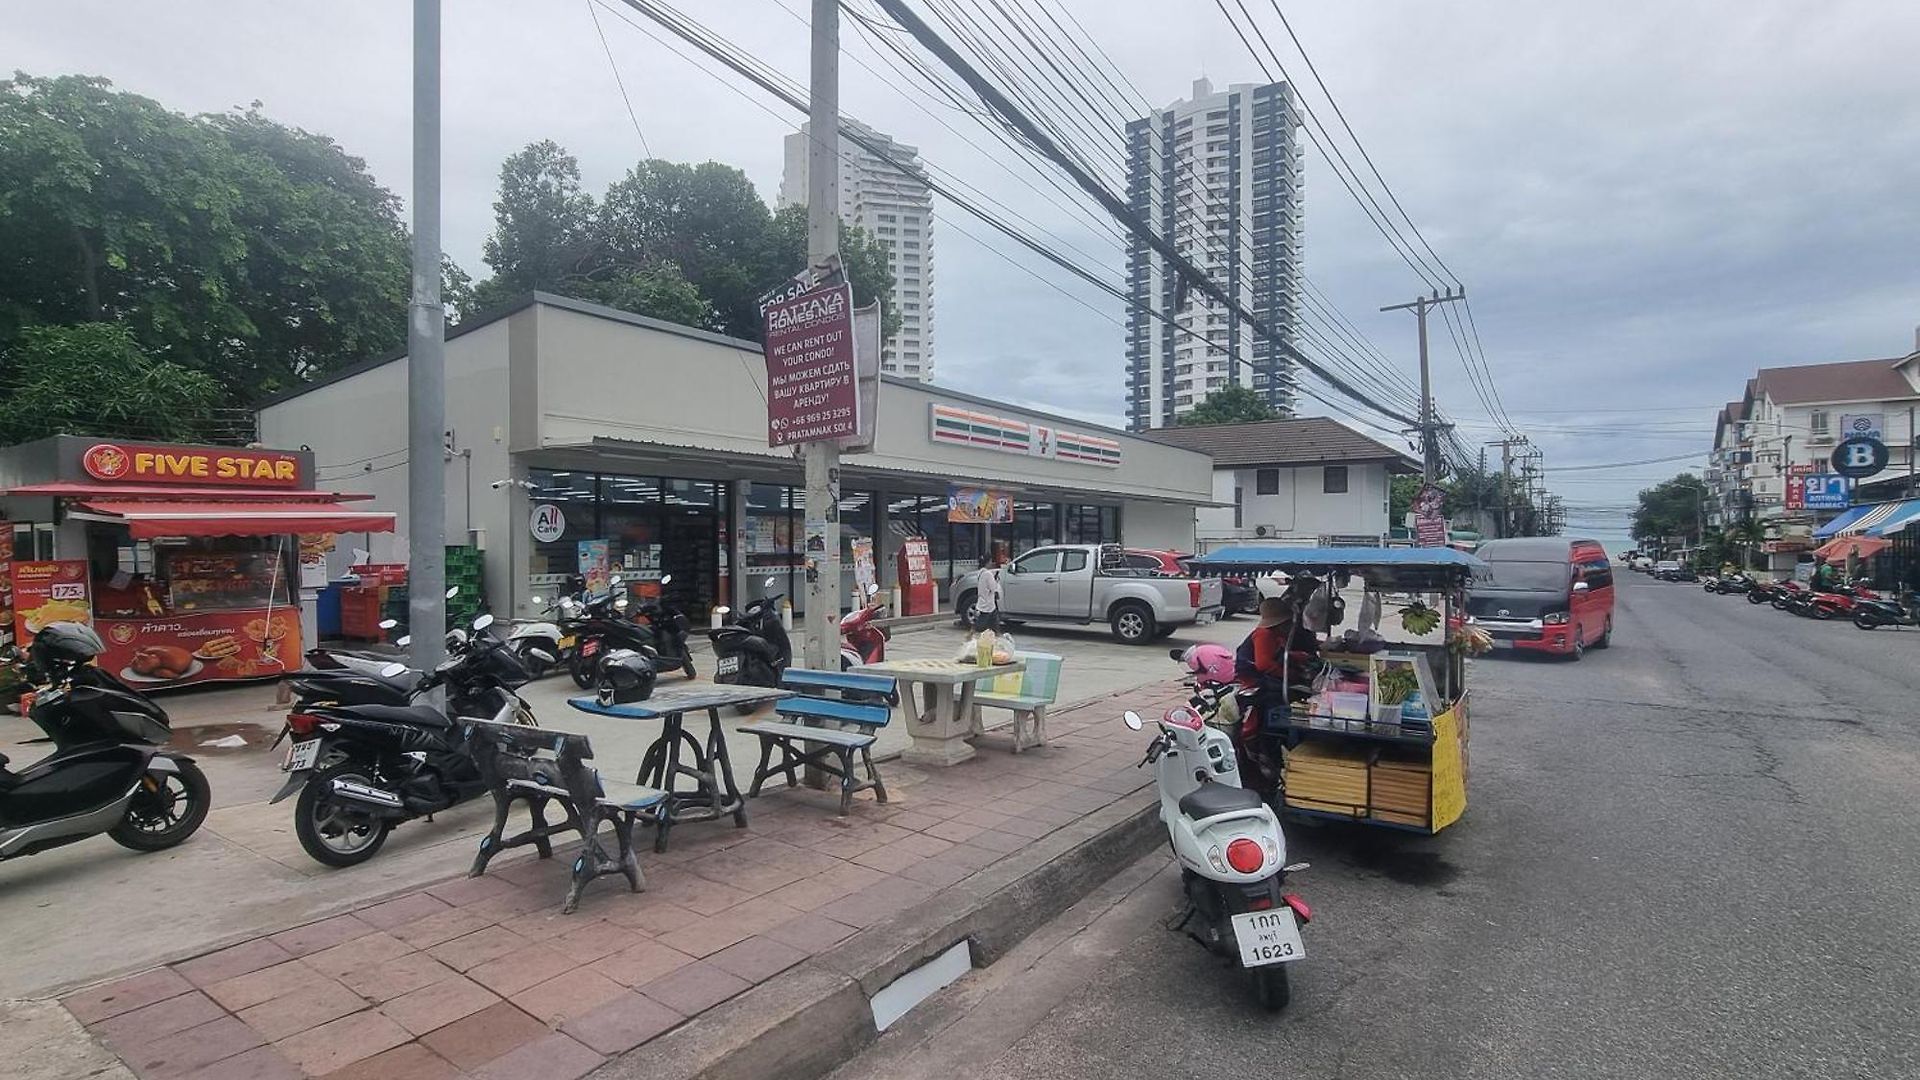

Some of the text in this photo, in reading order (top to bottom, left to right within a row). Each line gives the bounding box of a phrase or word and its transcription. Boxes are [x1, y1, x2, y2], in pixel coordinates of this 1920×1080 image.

[787, 273, 820, 300] SALE
[769, 292, 844, 320] PATTAYA
[769, 303, 843, 330] HOMES.NET
[774, 330, 843, 356] WE CAN RENT OUT
[783, 346, 835, 367] YOUR CONDO!
[772, 361, 850, 386] МЫ МОЖЕМ СДАТЬ
[774, 386, 797, 399] ВАШУ
[799, 377, 842, 394] КВАРТИРУ
[793, 393, 829, 409] АРЕНДУ!
[822, 410, 831, 420] 25
[135, 452, 295, 480] FIVE STAR
[1847, 443, 1875, 467] B
[1806, 477, 1845, 494] ยา
[54, 586, 82, 597] 175.-
[1252, 942, 1293, 961] 1623
